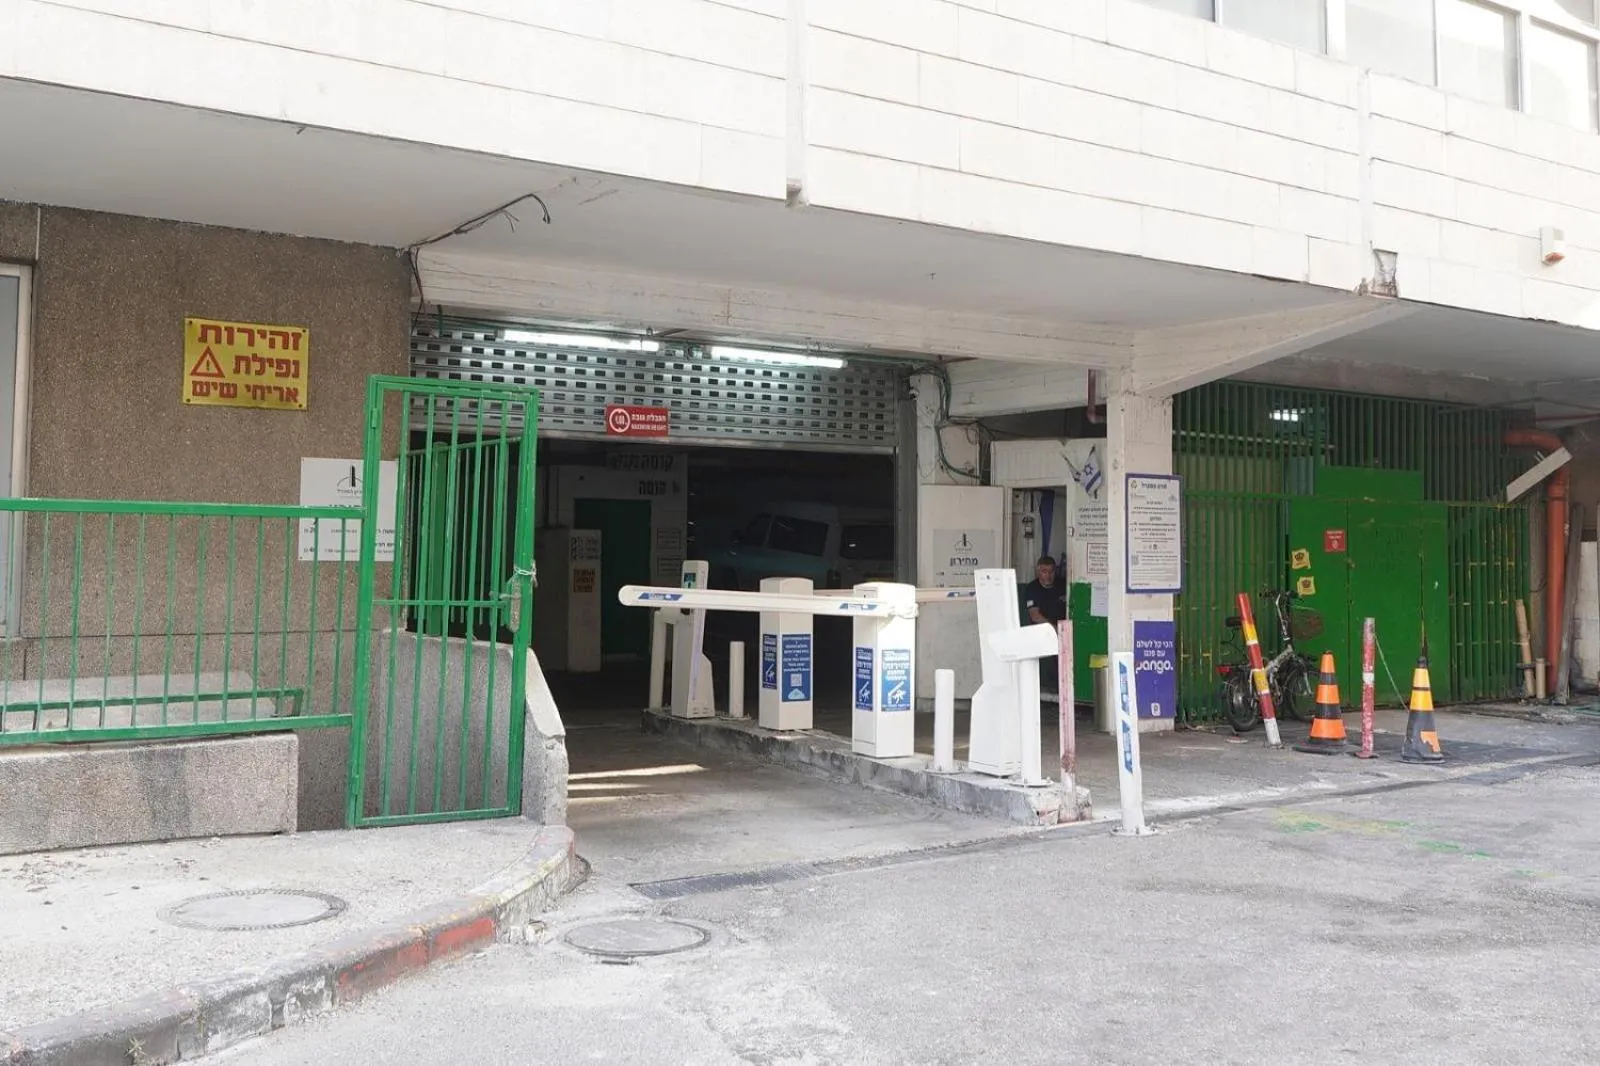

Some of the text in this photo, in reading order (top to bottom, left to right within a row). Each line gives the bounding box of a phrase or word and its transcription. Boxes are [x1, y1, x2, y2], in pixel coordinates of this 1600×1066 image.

[198, 324, 302, 351] זהירות
[233, 353, 300, 379] נפילת
[191, 380, 299, 404] אריחי שיש
[950, 557, 978, 567] מחירון
[1136, 639, 1174, 649] הכי קל לשלם
